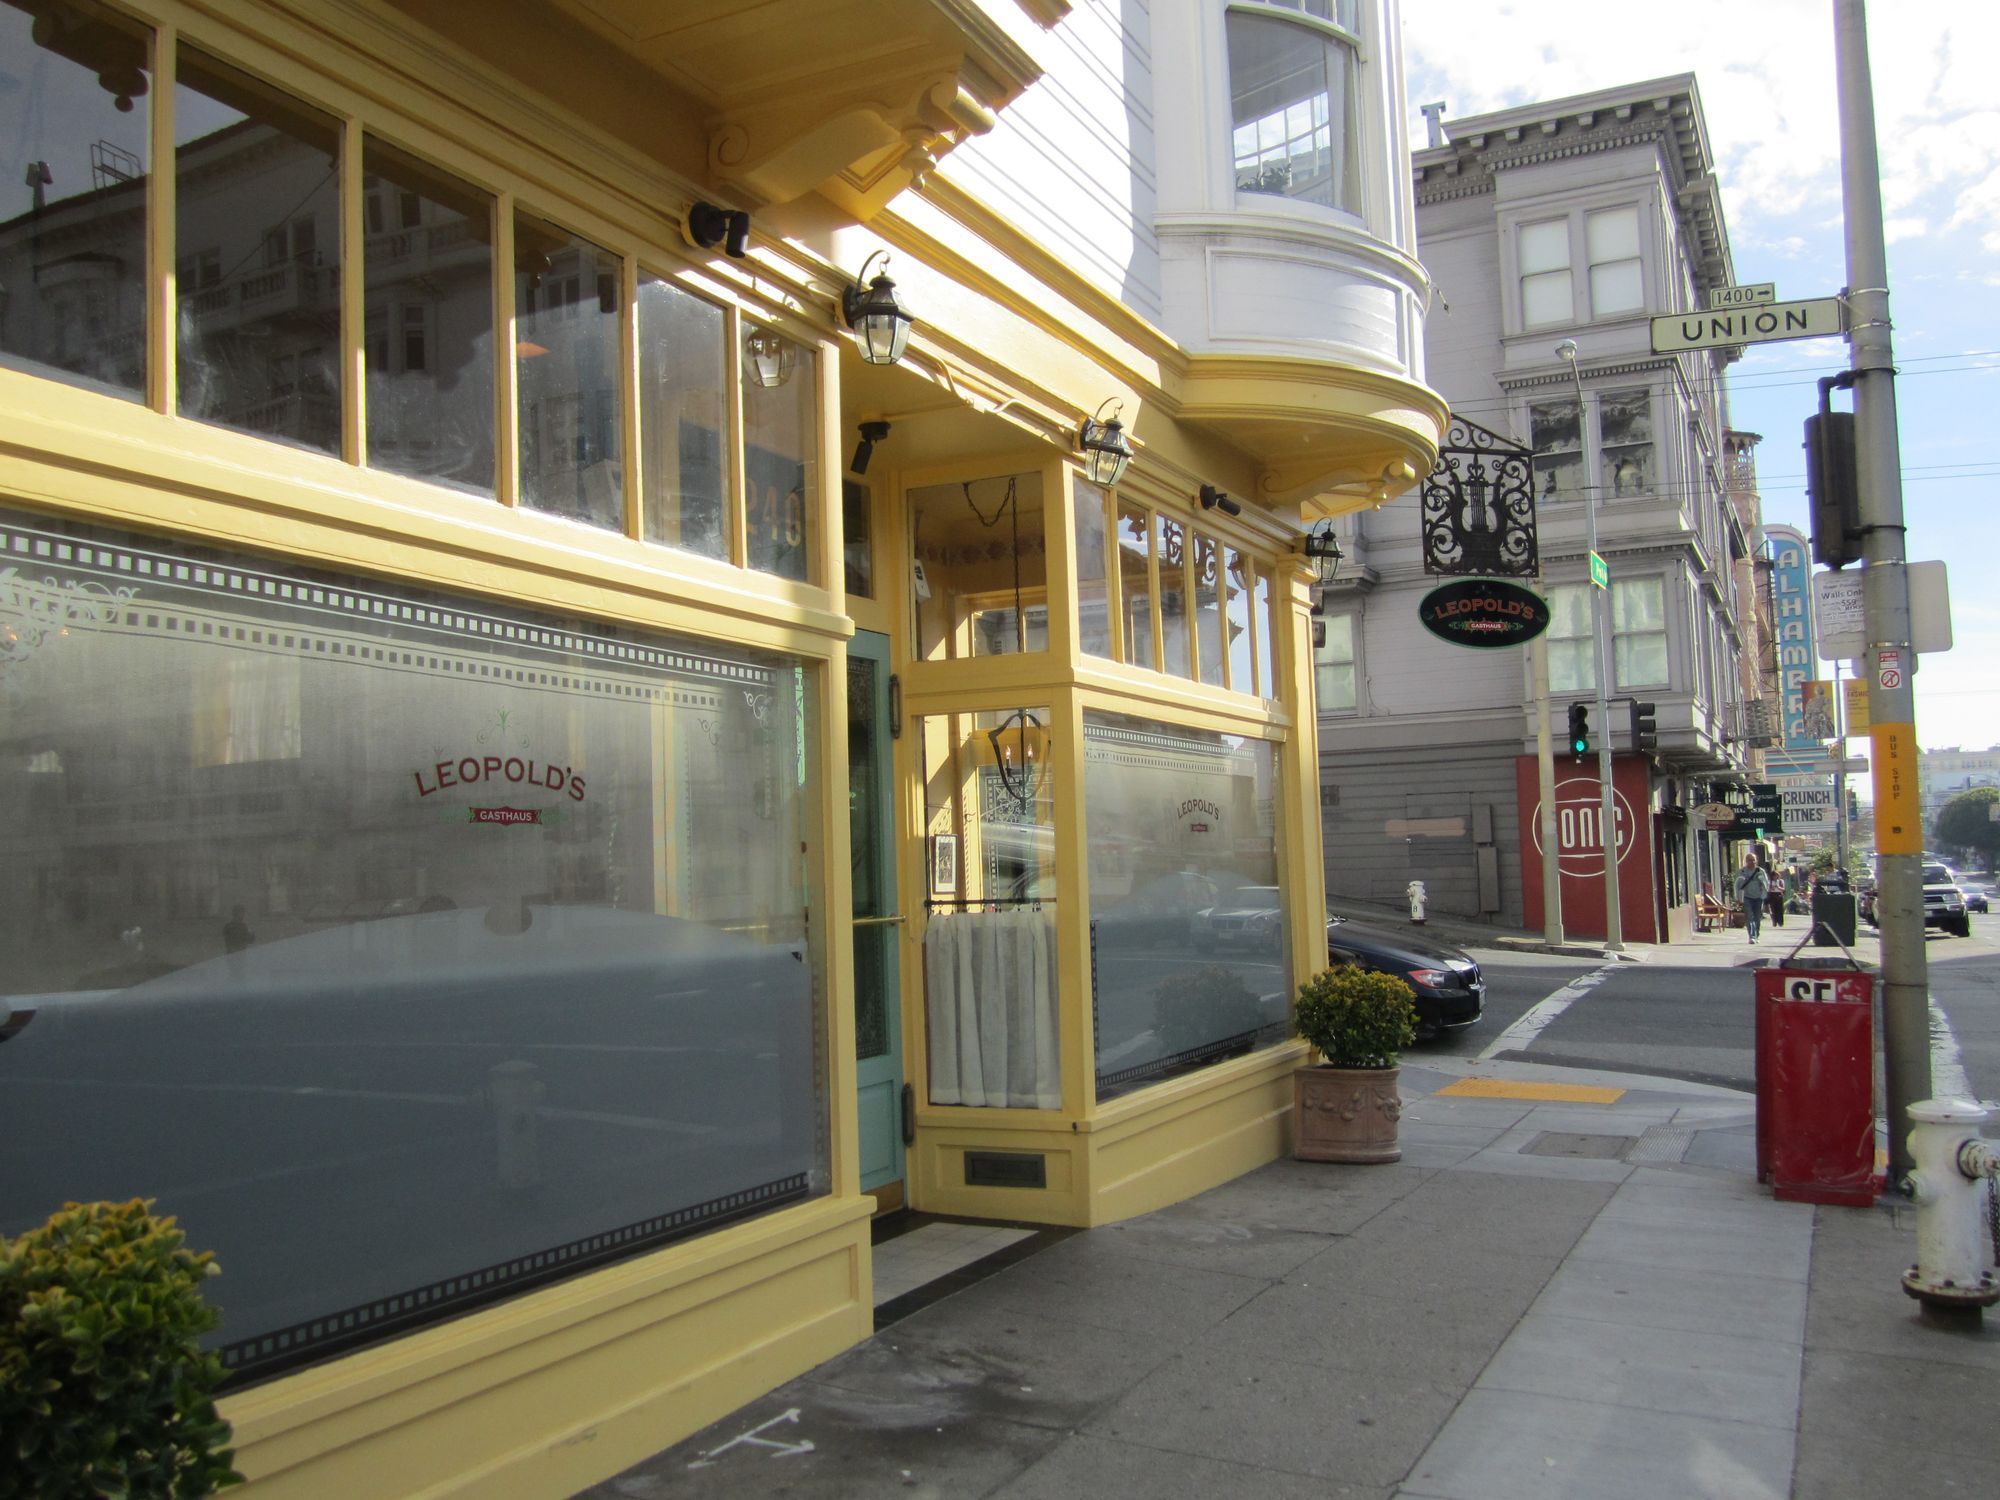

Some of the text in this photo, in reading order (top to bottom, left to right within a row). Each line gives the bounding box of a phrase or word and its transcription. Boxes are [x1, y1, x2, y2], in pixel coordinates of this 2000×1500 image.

[1717, 288, 1753, 304] 1400
[1682, 309, 1807, 341] UNION
[1435, 598, 1535, 620] LEOPOLD'S
[1777, 548, 1808, 741] ALHAMBRA
[1889, 735, 1897, 759] BUS
[414, 756, 586, 802] LEOPOLD'S
[1892, 767, 1900, 800] STOP
[1177, 799, 1219, 820] LEOPOLD'S
[1783, 791, 1831, 805] CRUNCH
[479, 811, 532, 822] GASTHAUS
[1560, 805, 1624, 849] ONIC
